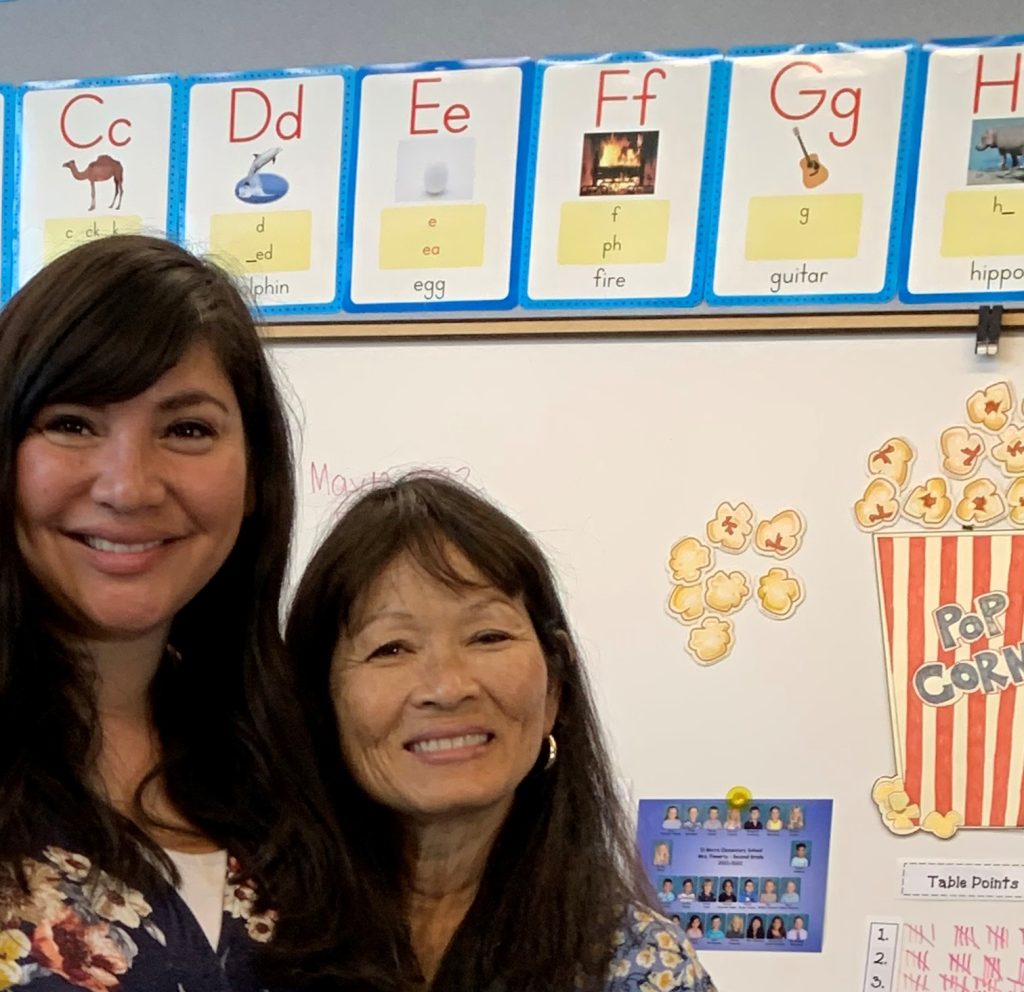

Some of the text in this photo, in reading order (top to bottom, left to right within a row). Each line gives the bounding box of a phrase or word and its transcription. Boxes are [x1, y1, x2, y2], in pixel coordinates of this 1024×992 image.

[409, 77, 471, 135] Ee
[596, 68, 666, 127] Ff
[770, 61, 862, 147] Gg
[60, 93, 132, 149] Cc
[229, 84, 303, 143] Dd
[256, 217, 265, 232] d
[428, 217, 437, 227] e
[612, 206, 621, 222] f
[800, 207, 809, 225] g
[422, 245, 440, 255] ea
[602, 235, 621, 258] ph
[239, 277, 289, 295] olphin
[593, 268, 626, 288] fire
[770, 263, 828, 293] guitar
[970, 261, 1024, 289] hippo
[413, 279, 446, 299] egg
[934, 591, 1007, 650] POP
[914, 643, 1024, 706] CORN
[927, 875, 1019, 890] Table Points
